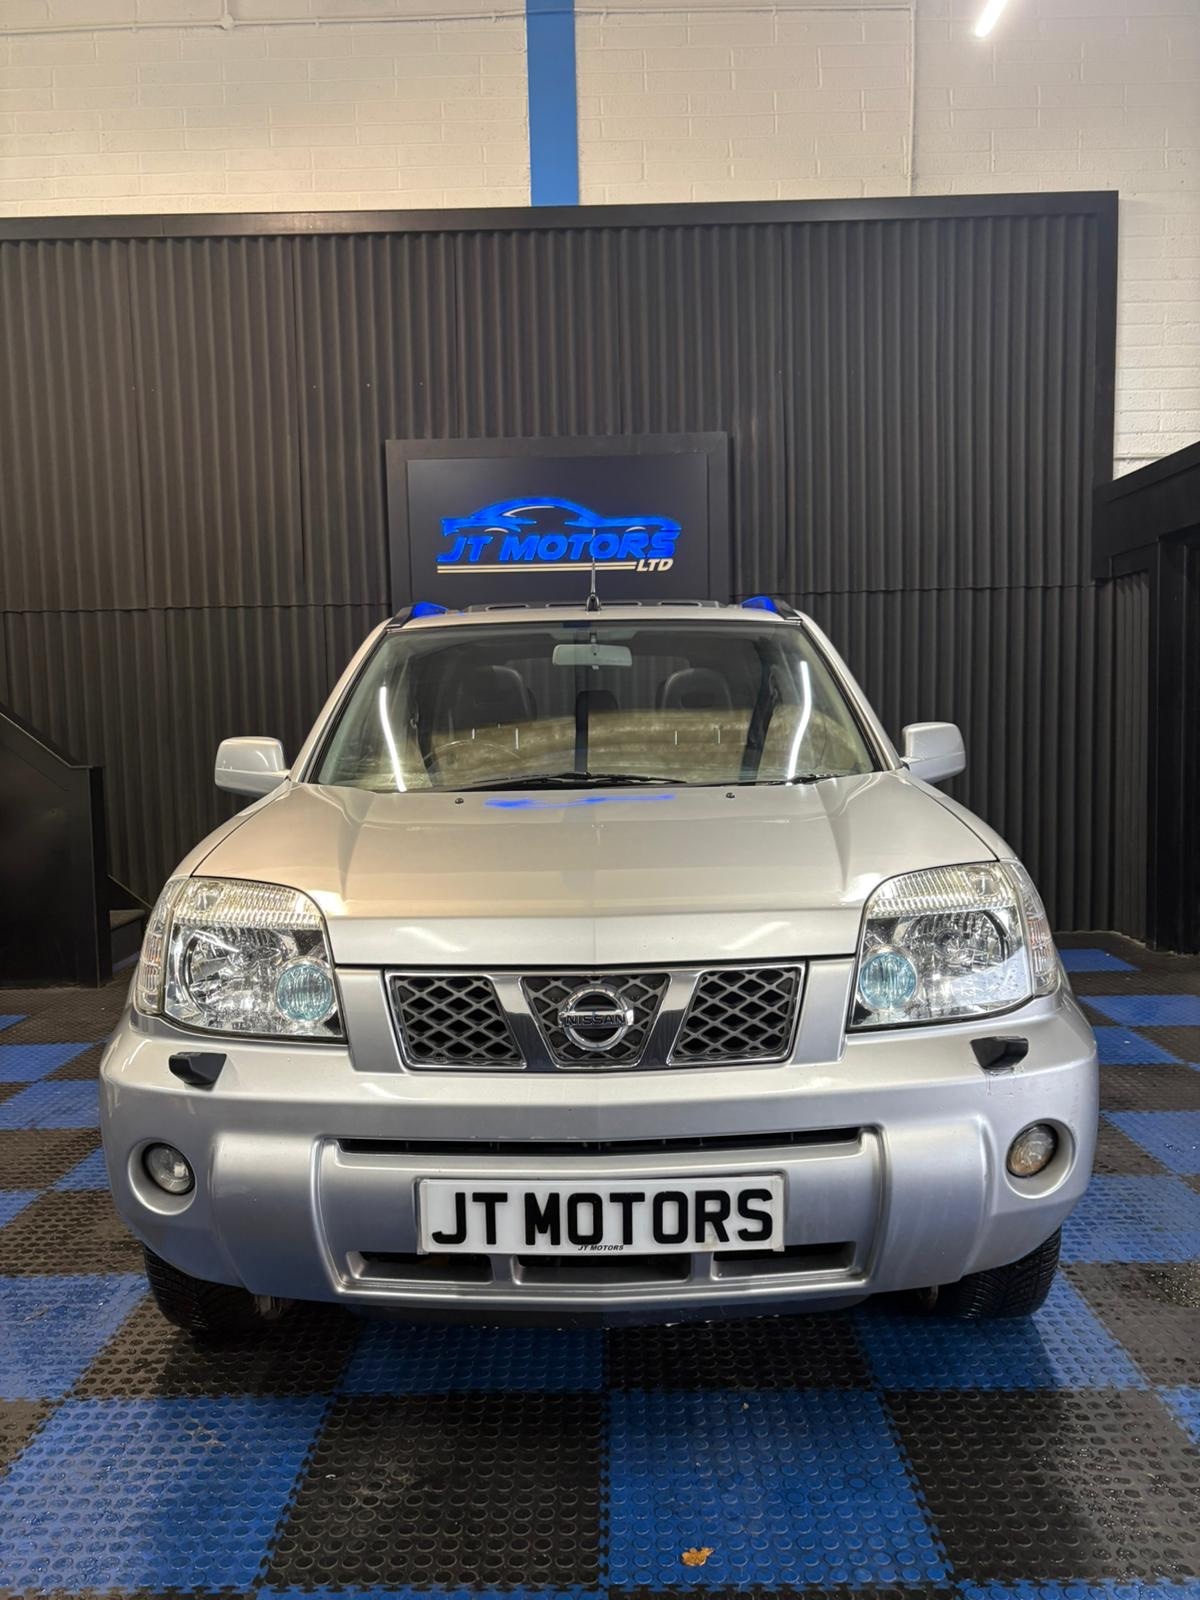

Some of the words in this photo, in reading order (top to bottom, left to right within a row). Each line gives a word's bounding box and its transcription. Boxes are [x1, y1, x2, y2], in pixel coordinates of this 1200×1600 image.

[437, 537, 492, 562] JT
[500, 531, 681, 561] MOTORS
[636, 558, 674, 572] LTD
[565, 1014, 625, 1026] NISSAN
[431, 1192, 508, 1245] JT
[524, 1188, 773, 1246] MOTORS
